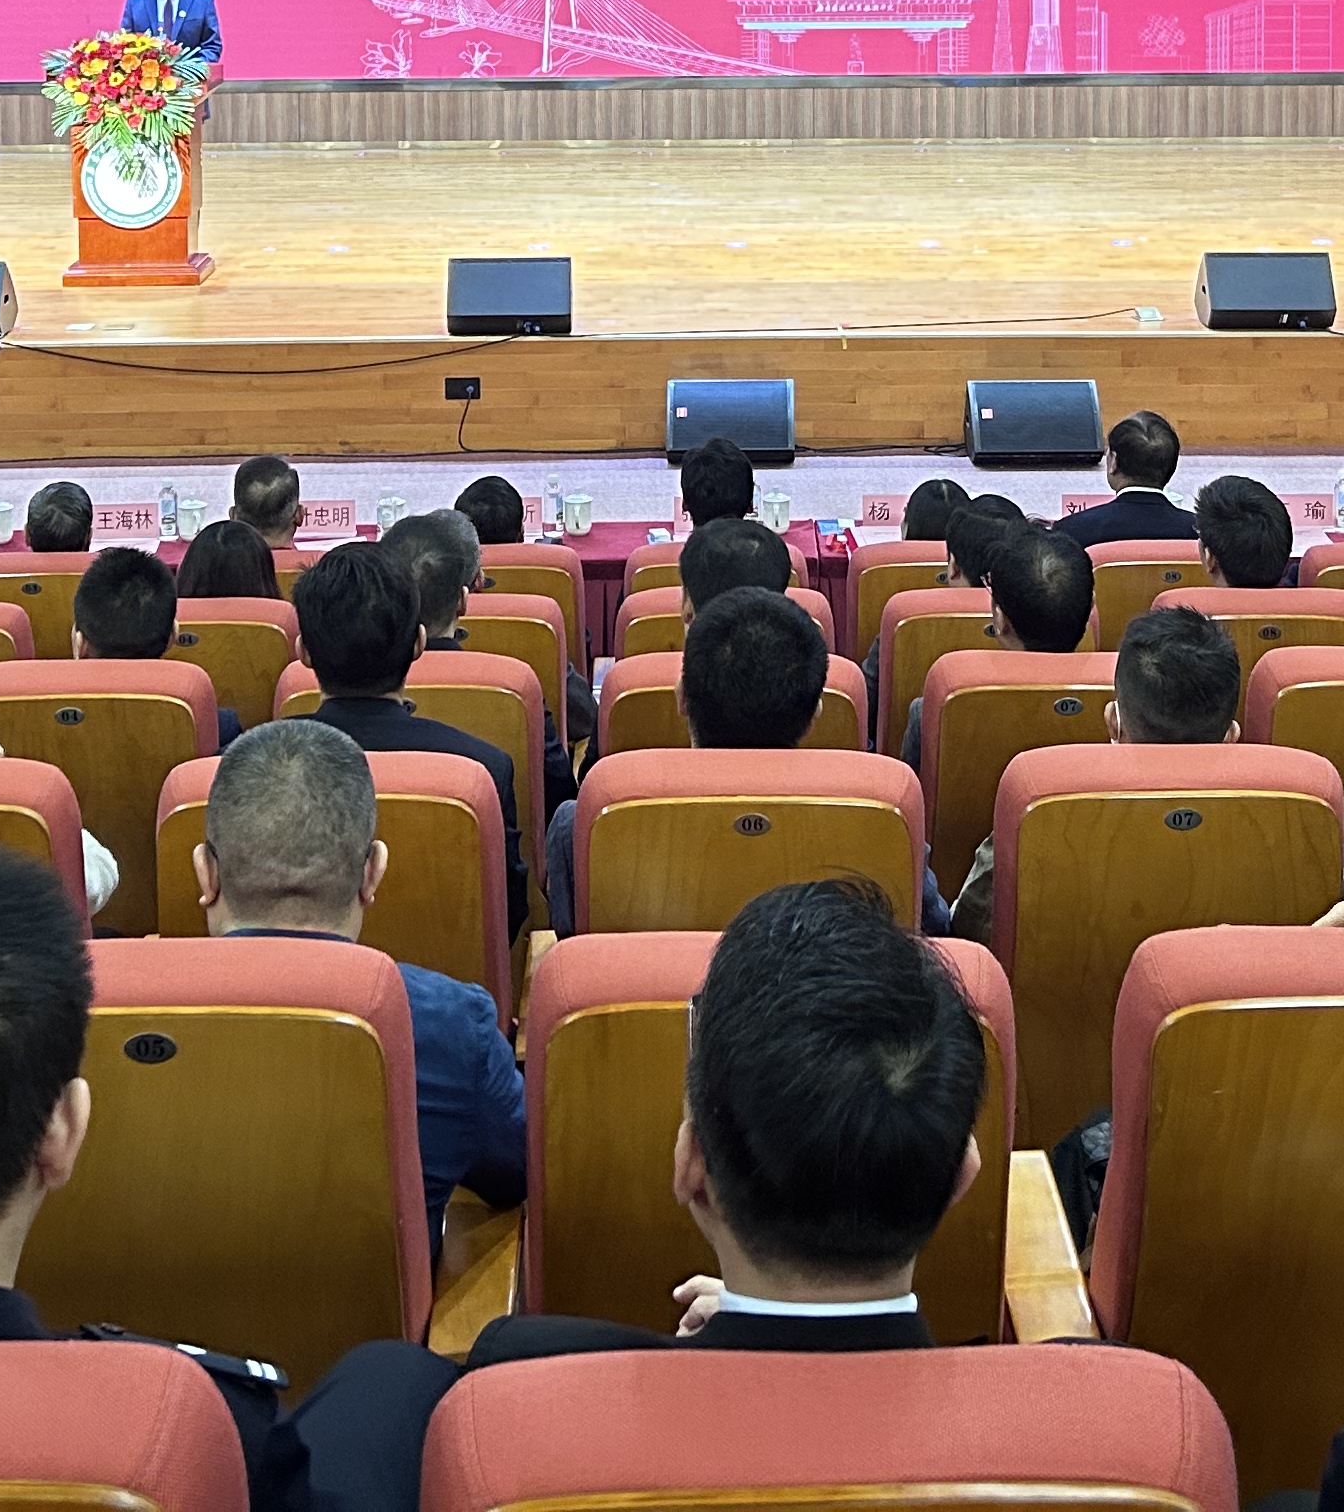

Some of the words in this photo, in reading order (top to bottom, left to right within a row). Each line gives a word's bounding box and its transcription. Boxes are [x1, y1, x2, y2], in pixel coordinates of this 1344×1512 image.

[868, 501, 891, 522] 杨
[96, 510, 153, 530] 王海林
[1164, 572, 1177, 582] 08
[1262, 628, 1277, 638] 08
[1060, 700, 1078, 711] 07
[61, 710, 78, 722] 04
[741, 817, 763, 832] 06
[1172, 812, 1193, 827] 07
[137, 1038, 165, 1057] 05
